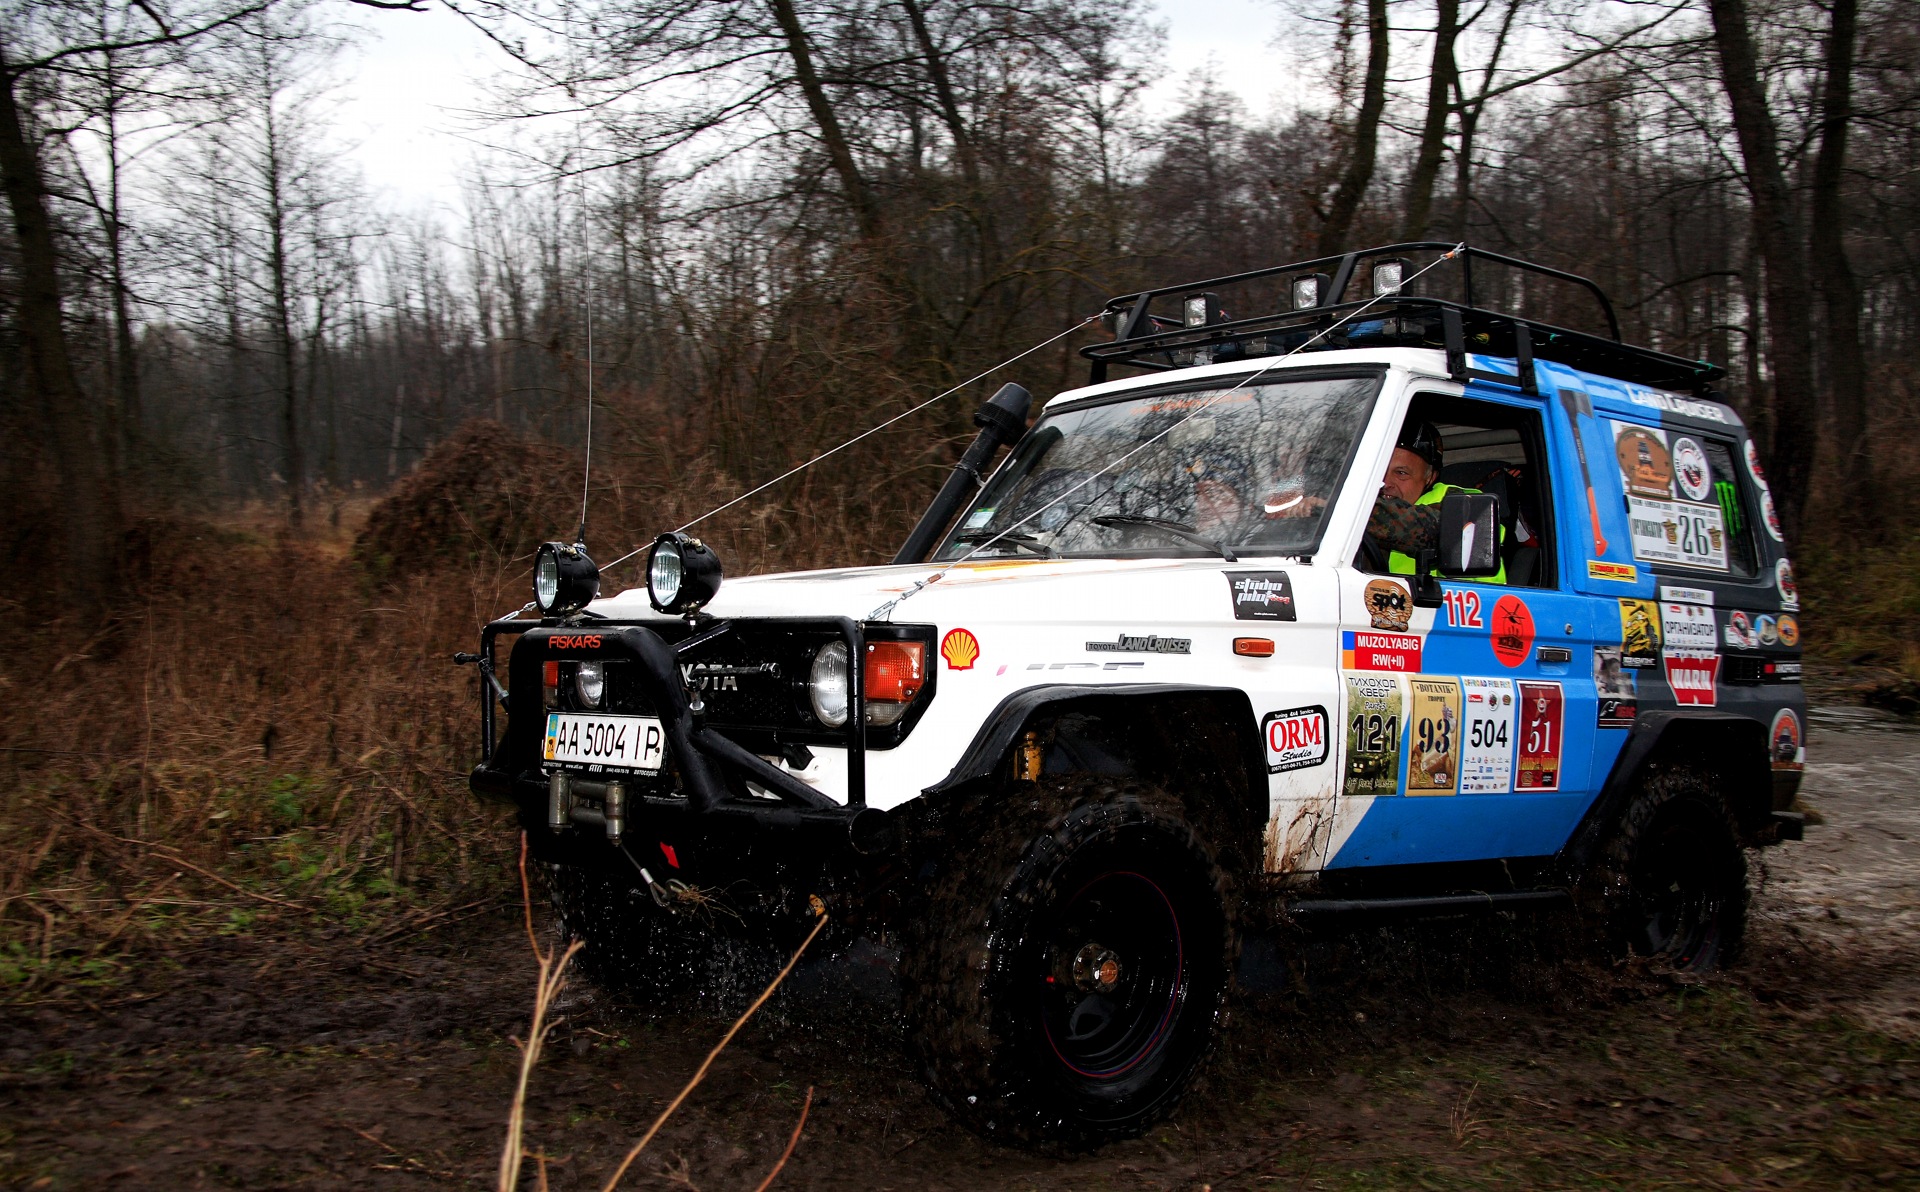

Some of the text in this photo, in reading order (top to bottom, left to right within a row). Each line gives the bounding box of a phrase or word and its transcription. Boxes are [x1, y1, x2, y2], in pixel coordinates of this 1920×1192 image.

[1678, 515, 1709, 556] 26
[1234, 578, 1283, 593] studio
[1236, 590, 1272, 607] pilot
[1444, 590, 1482, 628] 112
[1664, 620, 1714, 636] ОРГАНИЗАТОР
[548, 634, 602, 648] FISKARS
[1358, 636, 1419, 650] MUZOLYABIG
[1372, 653, 1405, 669] RW(+II)
[1348, 678, 1396, 688] ТИХОХОД
[1671, 668, 1712, 690] WARN
[1359, 688, 1390, 698] КВЕСТ
[556, 722, 660, 760] AA 5004 IP
[1270, 716, 1322, 752] ORM
[1352, 714, 1398, 752] 121
[1418, 718, 1451, 754] 93
[1470, 719, 1508, 748] 504
[1527, 718, 1552, 754] 51
[1280, 748, 1312, 762] Studio
